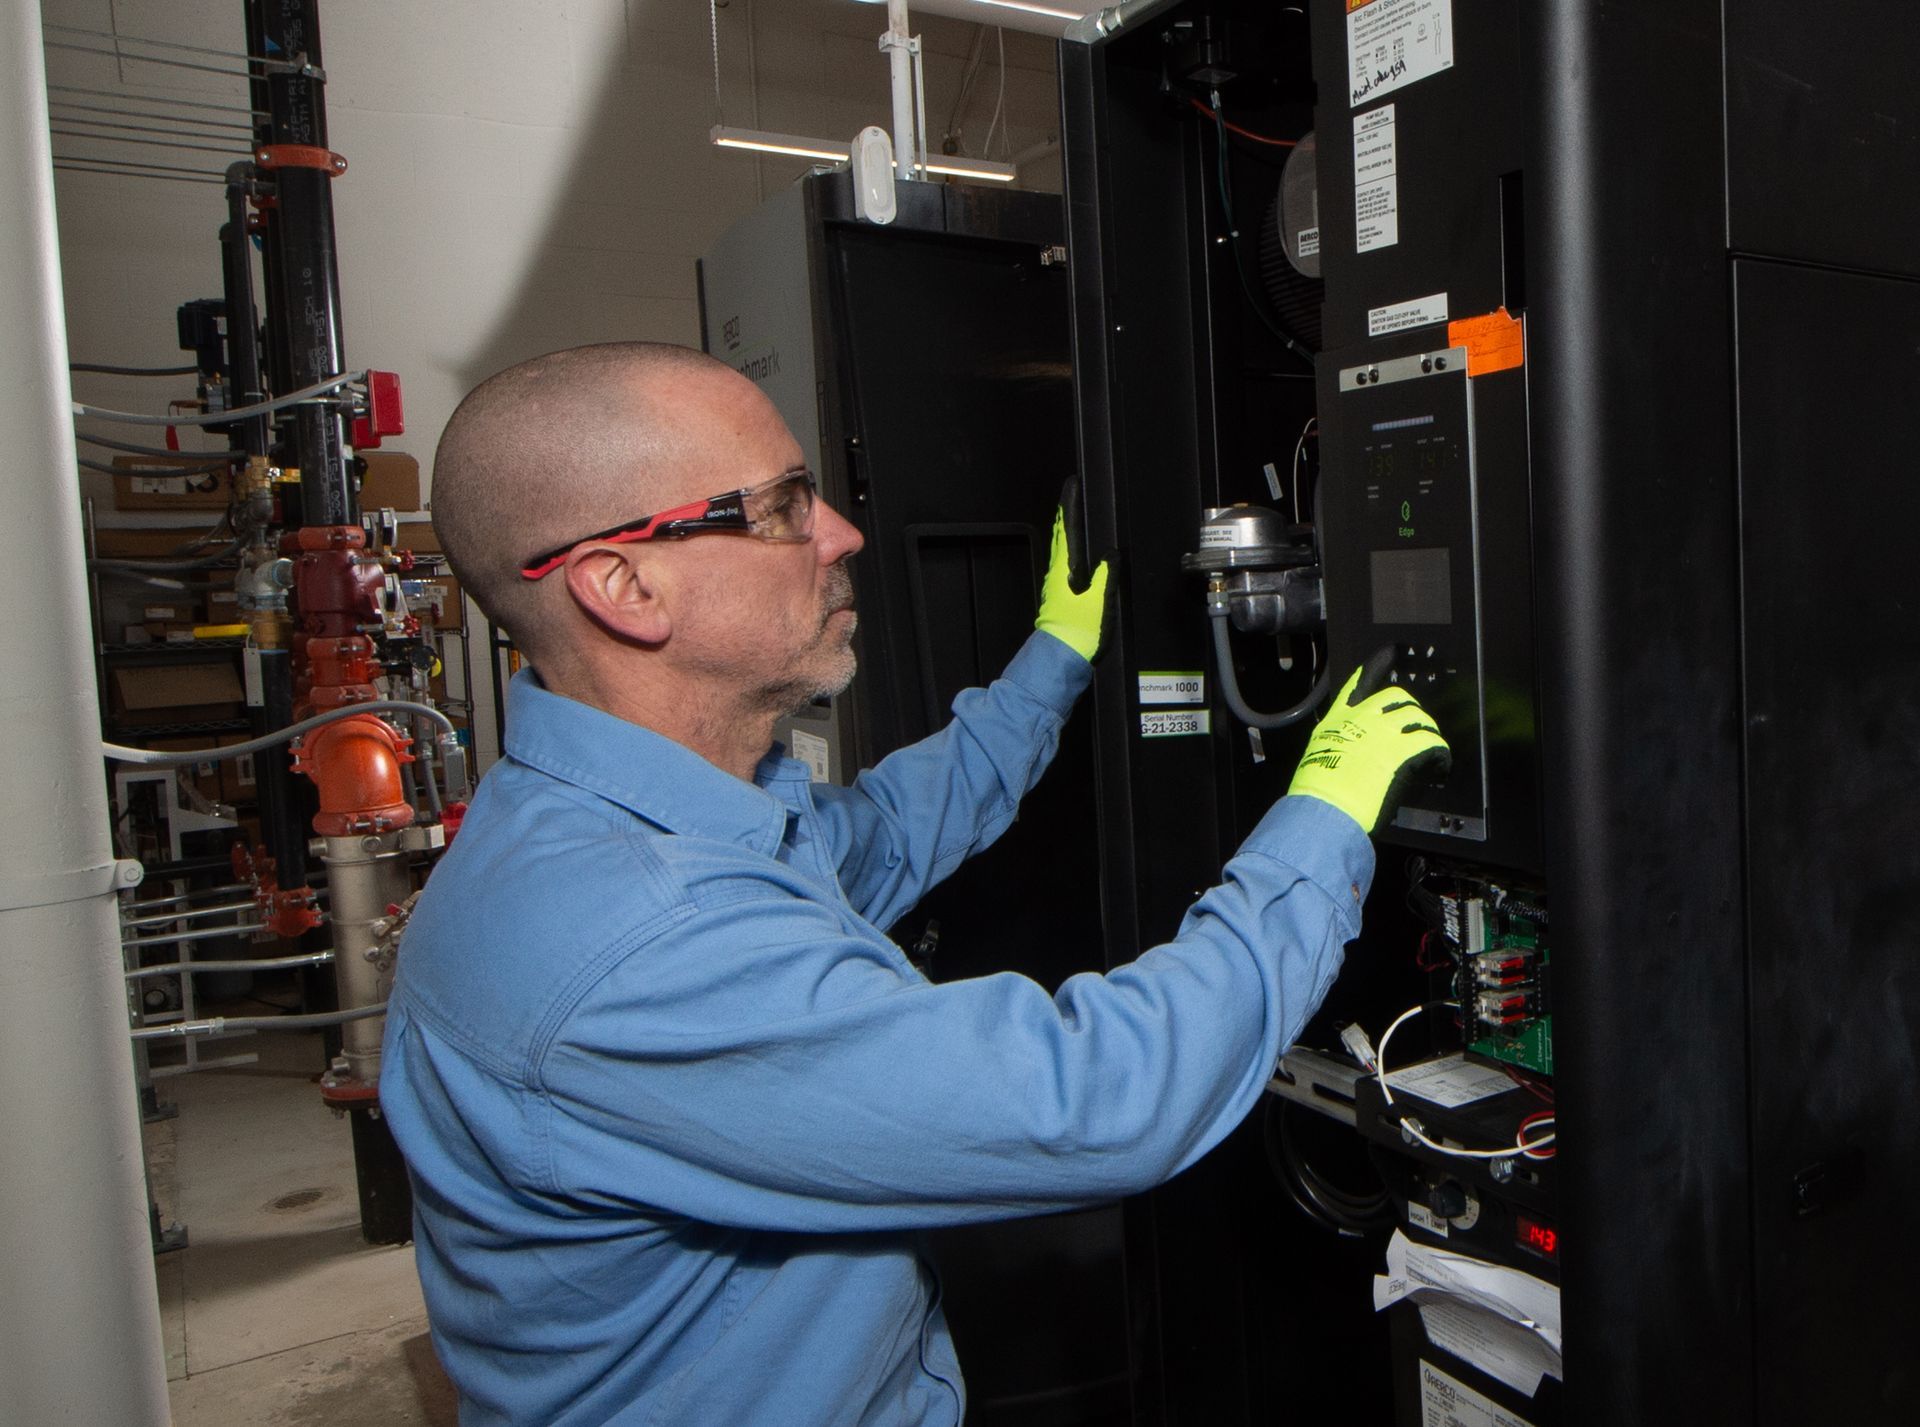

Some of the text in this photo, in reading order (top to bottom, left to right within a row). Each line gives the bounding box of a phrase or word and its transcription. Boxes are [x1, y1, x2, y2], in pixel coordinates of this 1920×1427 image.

[1399, 527, 1414, 537] Edge
[1139, 682, 1199, 693] nchmark 1000
[1144, 713, 1193, 722] Serial Number
[1529, 1224, 1556, 1252] 143
